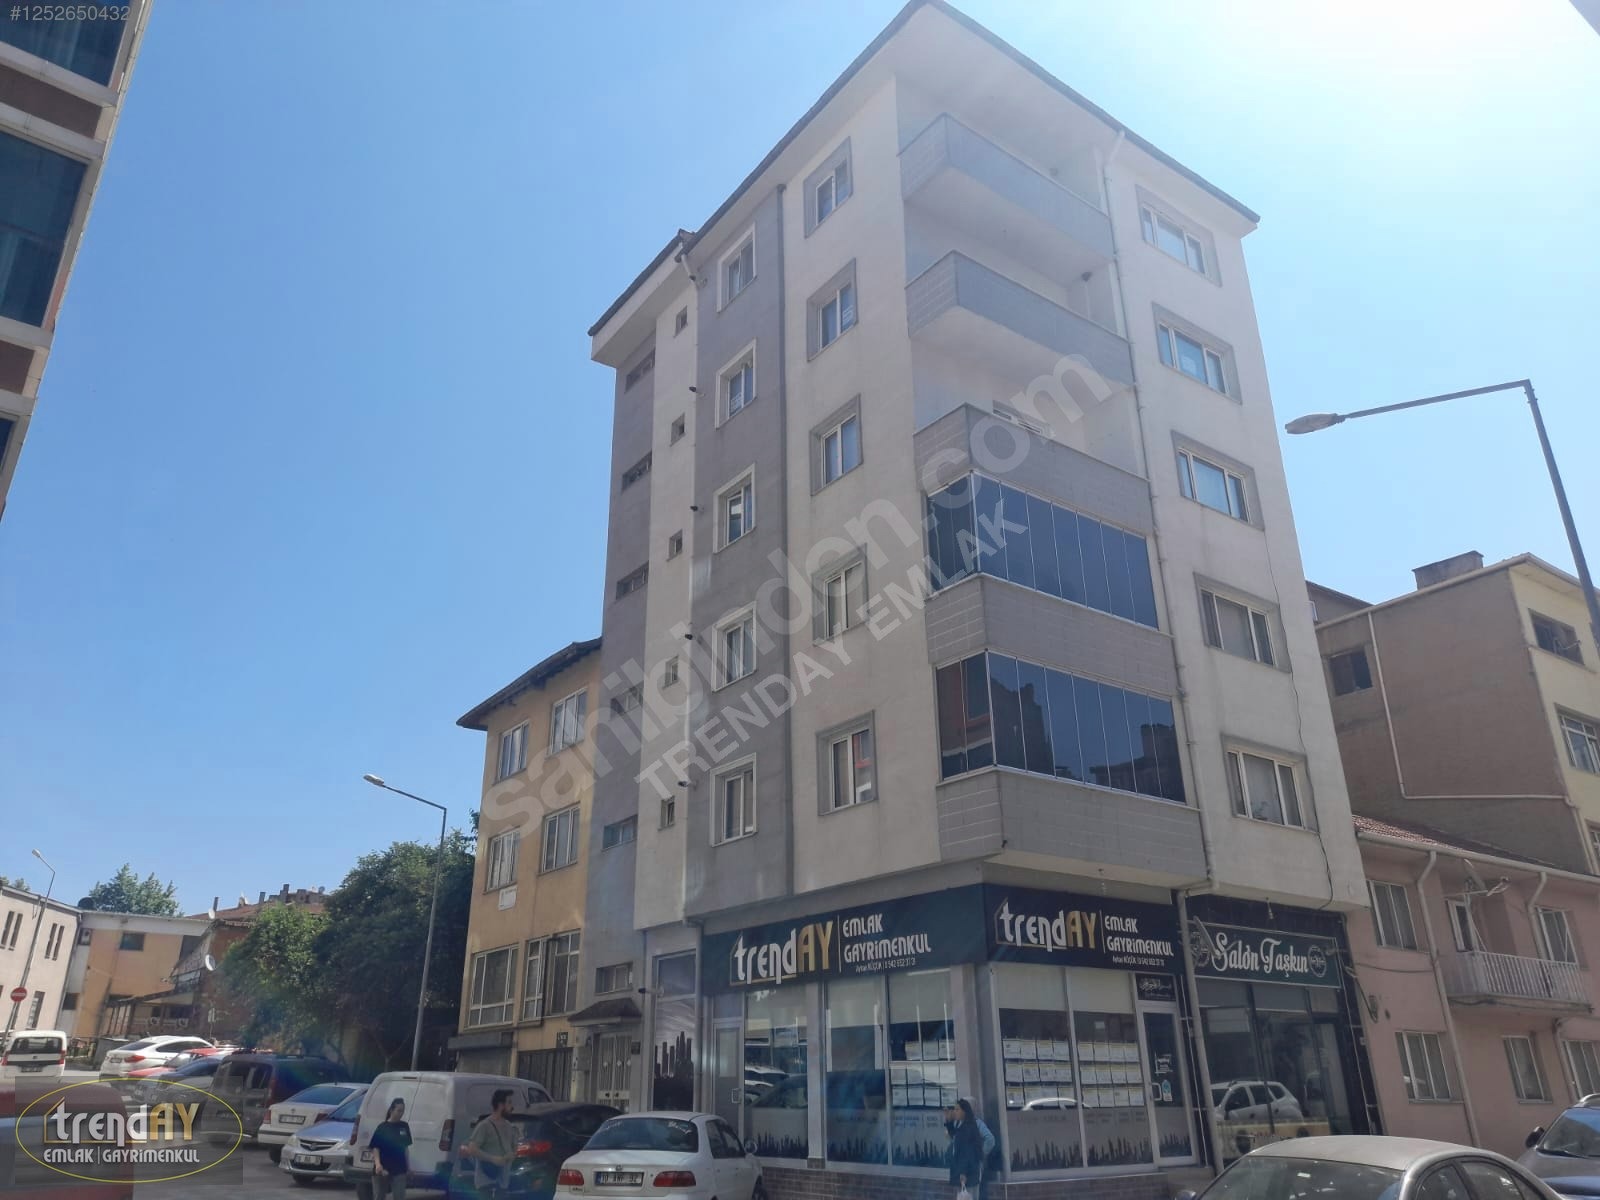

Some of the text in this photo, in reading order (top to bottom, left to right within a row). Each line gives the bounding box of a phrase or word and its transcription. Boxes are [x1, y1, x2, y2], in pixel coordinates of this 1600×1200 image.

[843, 914, 883, 937] EMLAK
[1000, 901, 1096, 952] trendAY
[1105, 915, 1138, 933] EMLAK
[734, 921, 833, 984] trendAY
